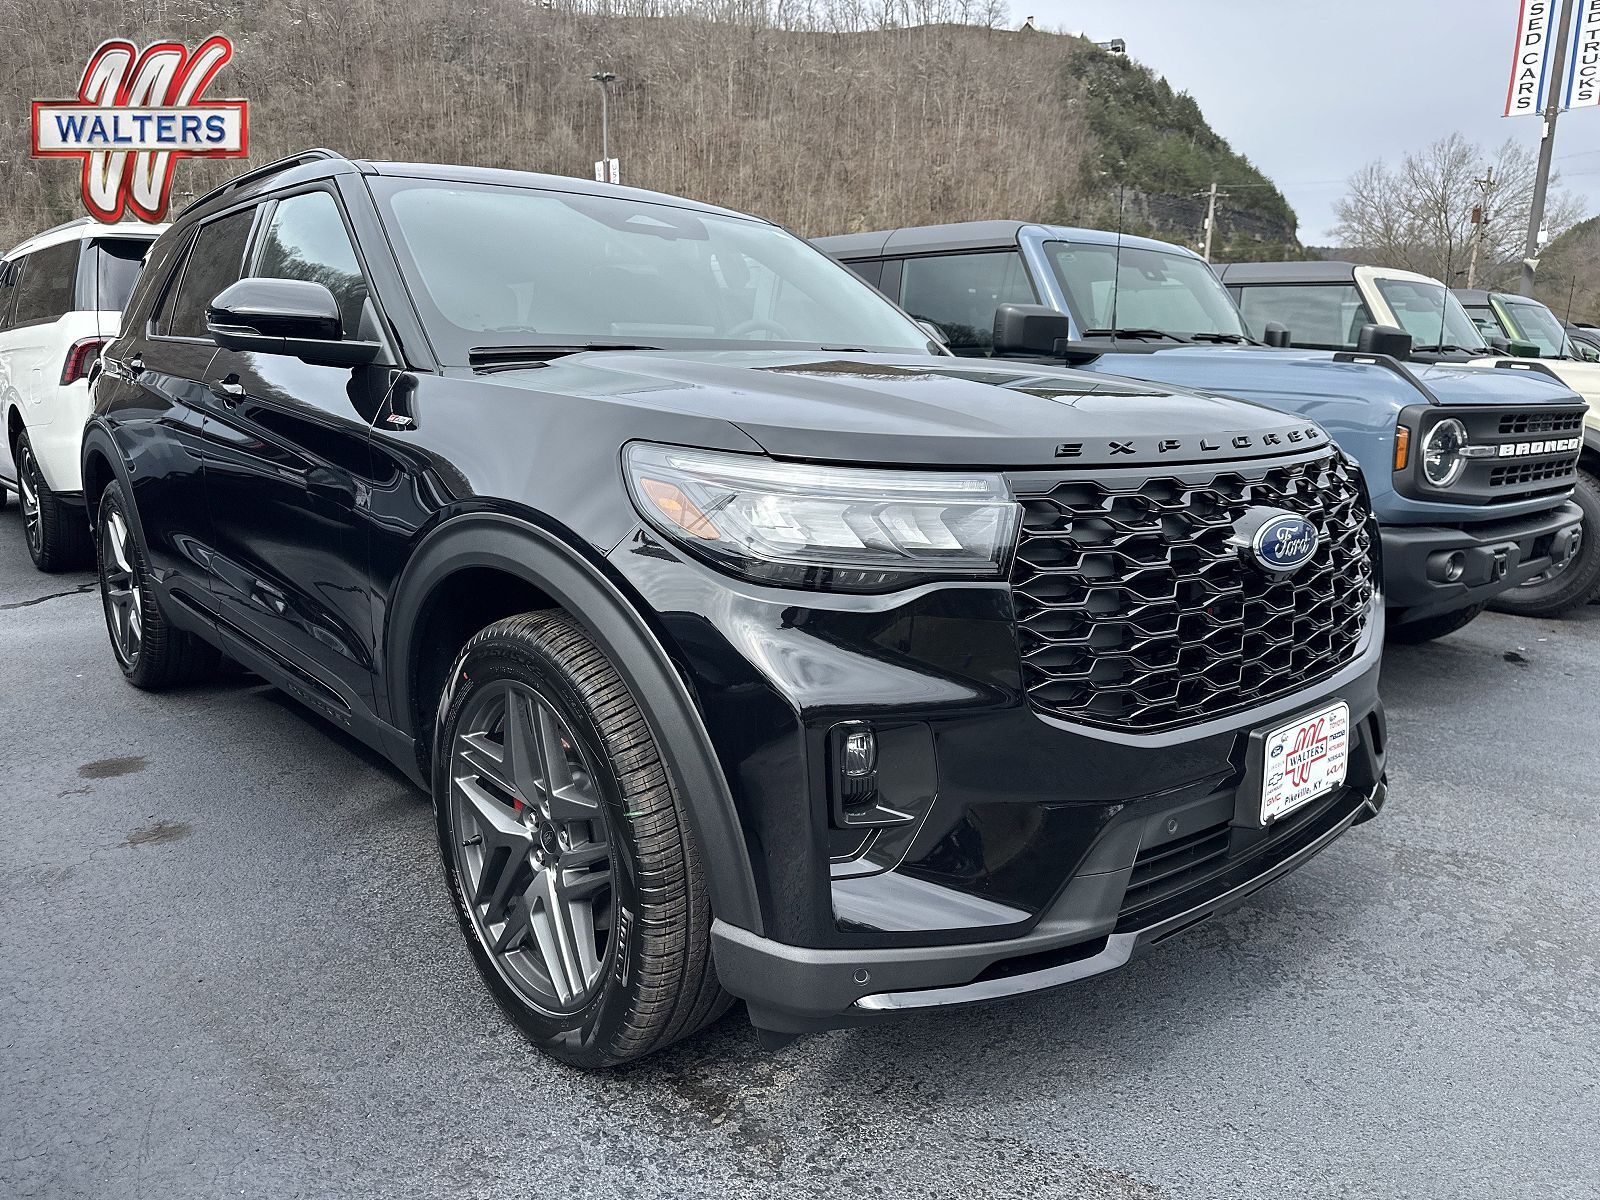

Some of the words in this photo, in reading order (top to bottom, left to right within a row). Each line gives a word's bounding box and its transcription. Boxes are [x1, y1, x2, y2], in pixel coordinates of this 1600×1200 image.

[1525, 0, 1545, 46] SED
[1578, 29, 1600, 101] TRUCKS
[1517, 52, 1539, 109] CARS
[1055, 427, 1320, 458] EXPLORER
[1499, 438, 1579, 457] BRONCO
[1274, 526, 1310, 560] Ford
[1329, 718, 1345, 730] TOYOTA
[1290, 743, 1324, 766] WALTERS
[1266, 792, 1282, 807] GMC
[1284, 787, 1312, 805] Pikeville,
[1313, 779, 1323, 791] KY
